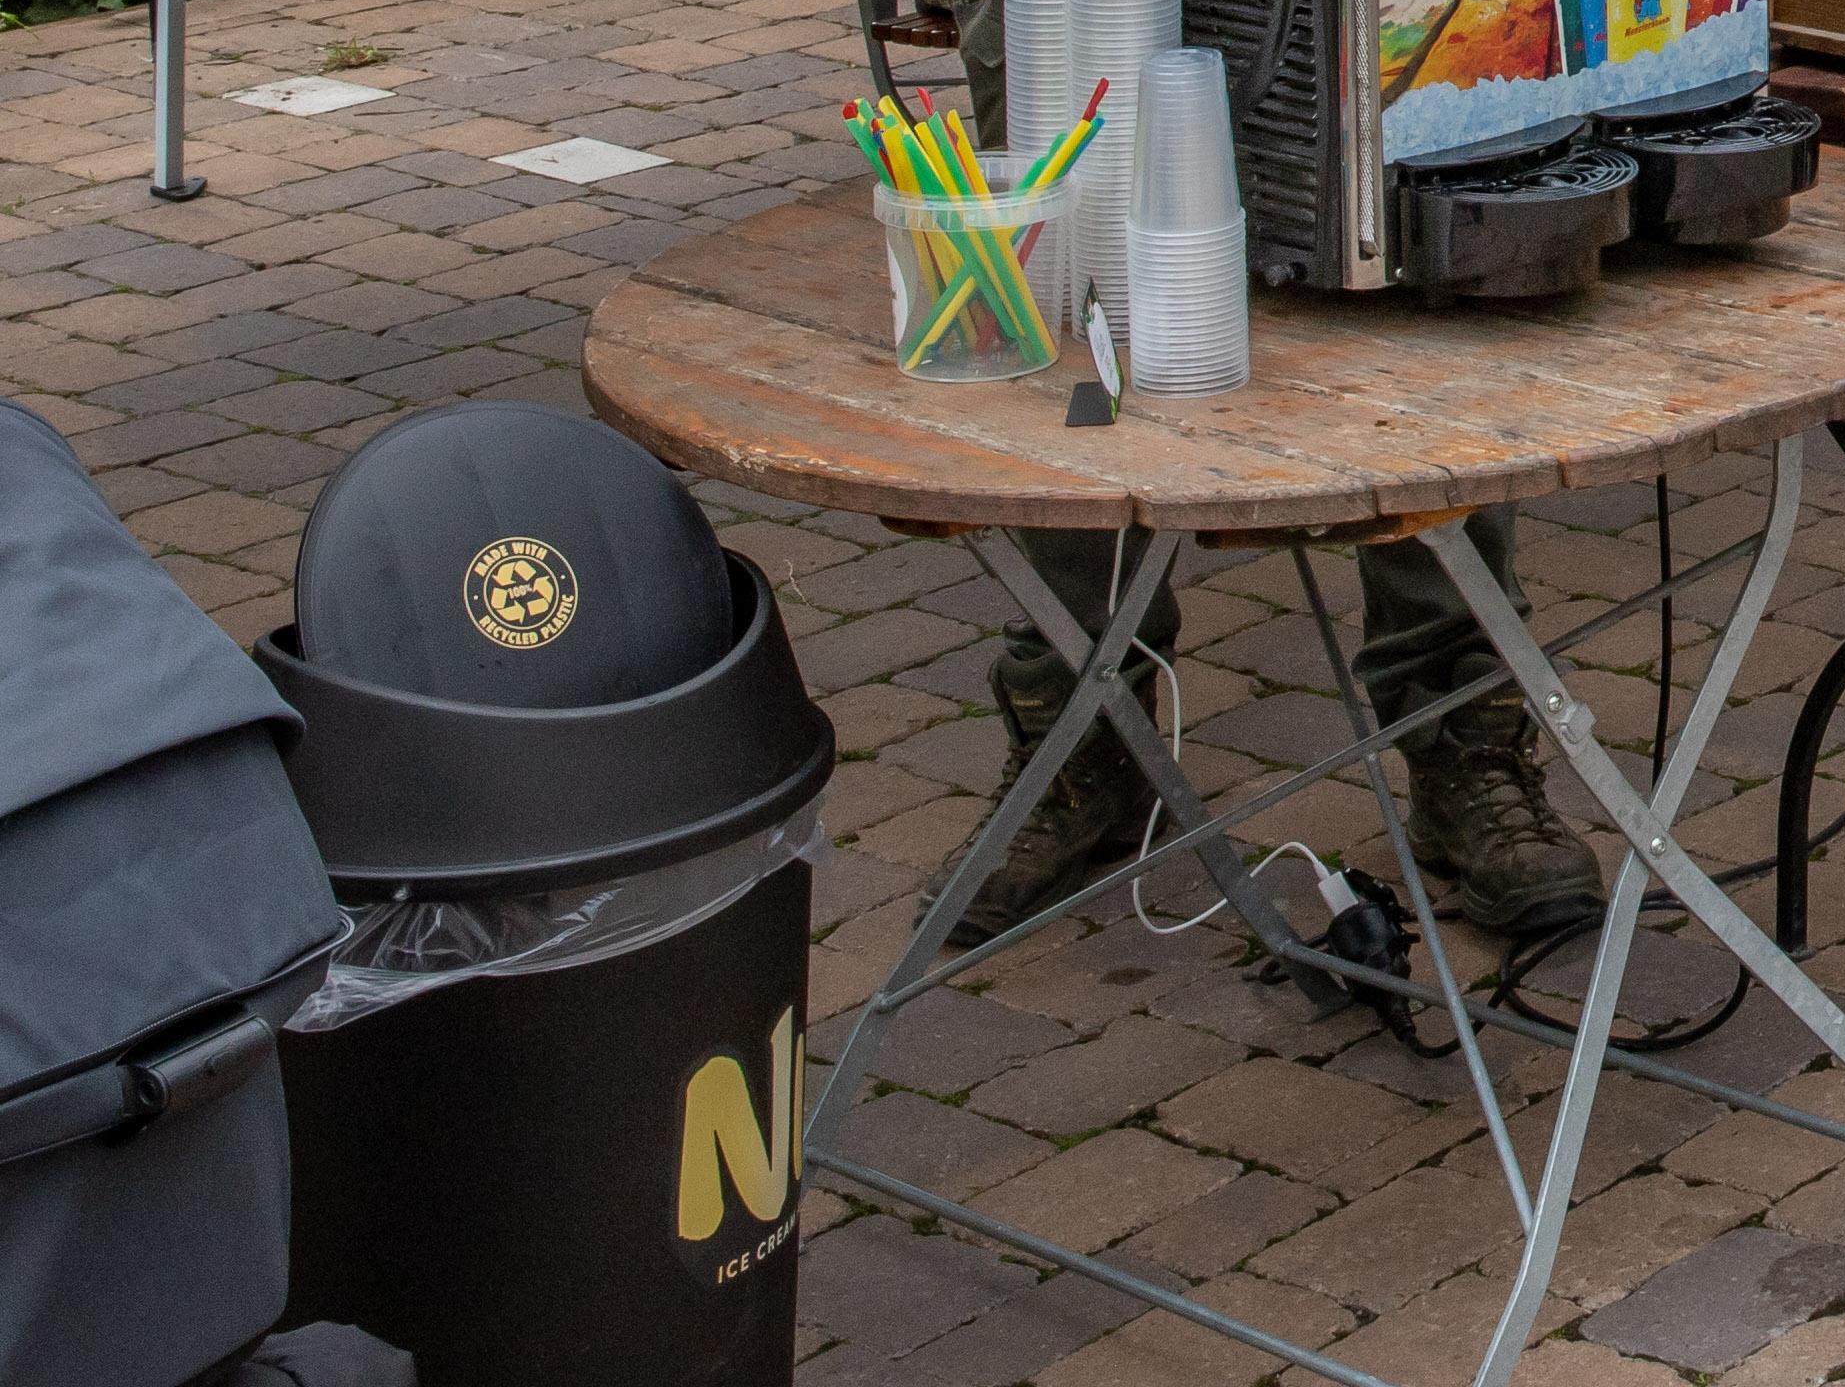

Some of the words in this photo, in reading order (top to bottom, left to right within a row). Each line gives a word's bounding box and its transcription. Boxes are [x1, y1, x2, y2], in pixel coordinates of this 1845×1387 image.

[474, 544, 509, 577] MADE
[512, 542, 548, 560] WITH
[479, 615, 539, 645] RECYCLED
[540, 594, 574, 639] PLASTIC
[718, 1251, 750, 1284] ICE
